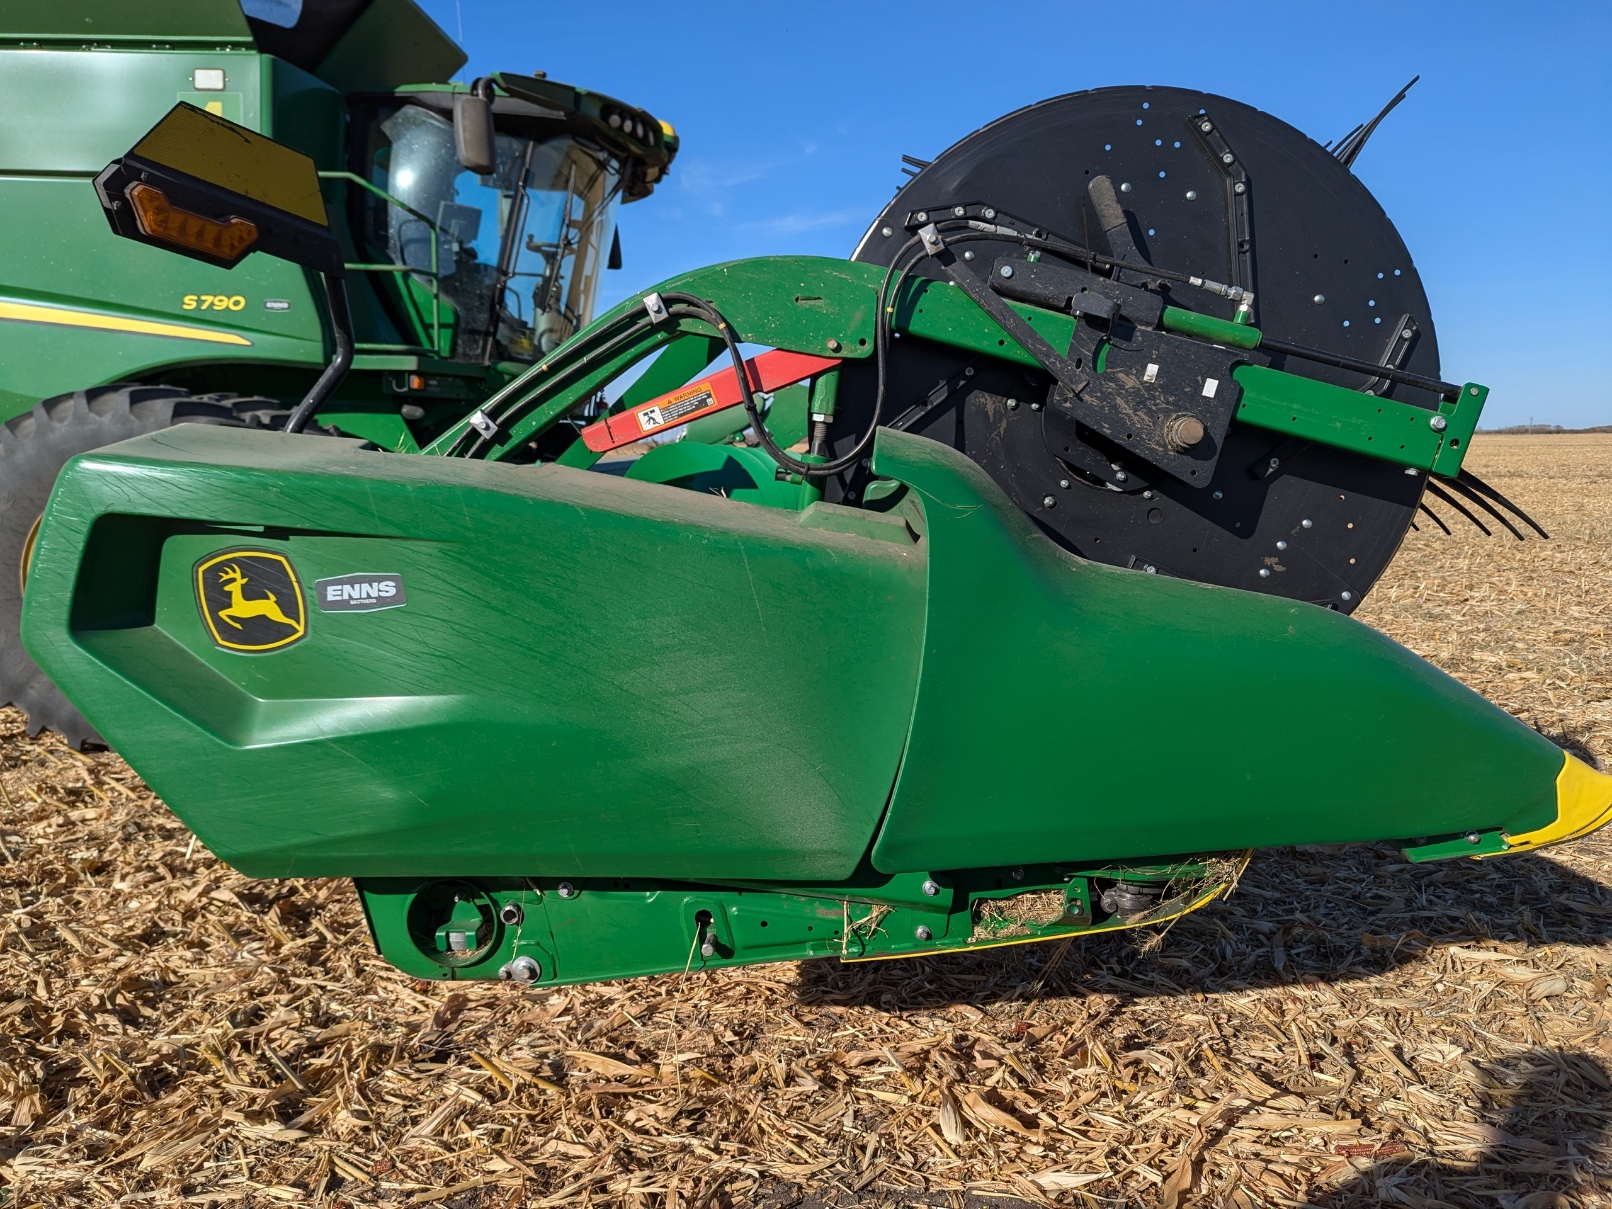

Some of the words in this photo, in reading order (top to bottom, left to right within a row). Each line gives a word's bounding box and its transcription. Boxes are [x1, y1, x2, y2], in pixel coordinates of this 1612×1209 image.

[182, 295, 246, 311] S790
[674, 387, 702, 402] WARNING
[326, 581, 397, 601] ENNS
